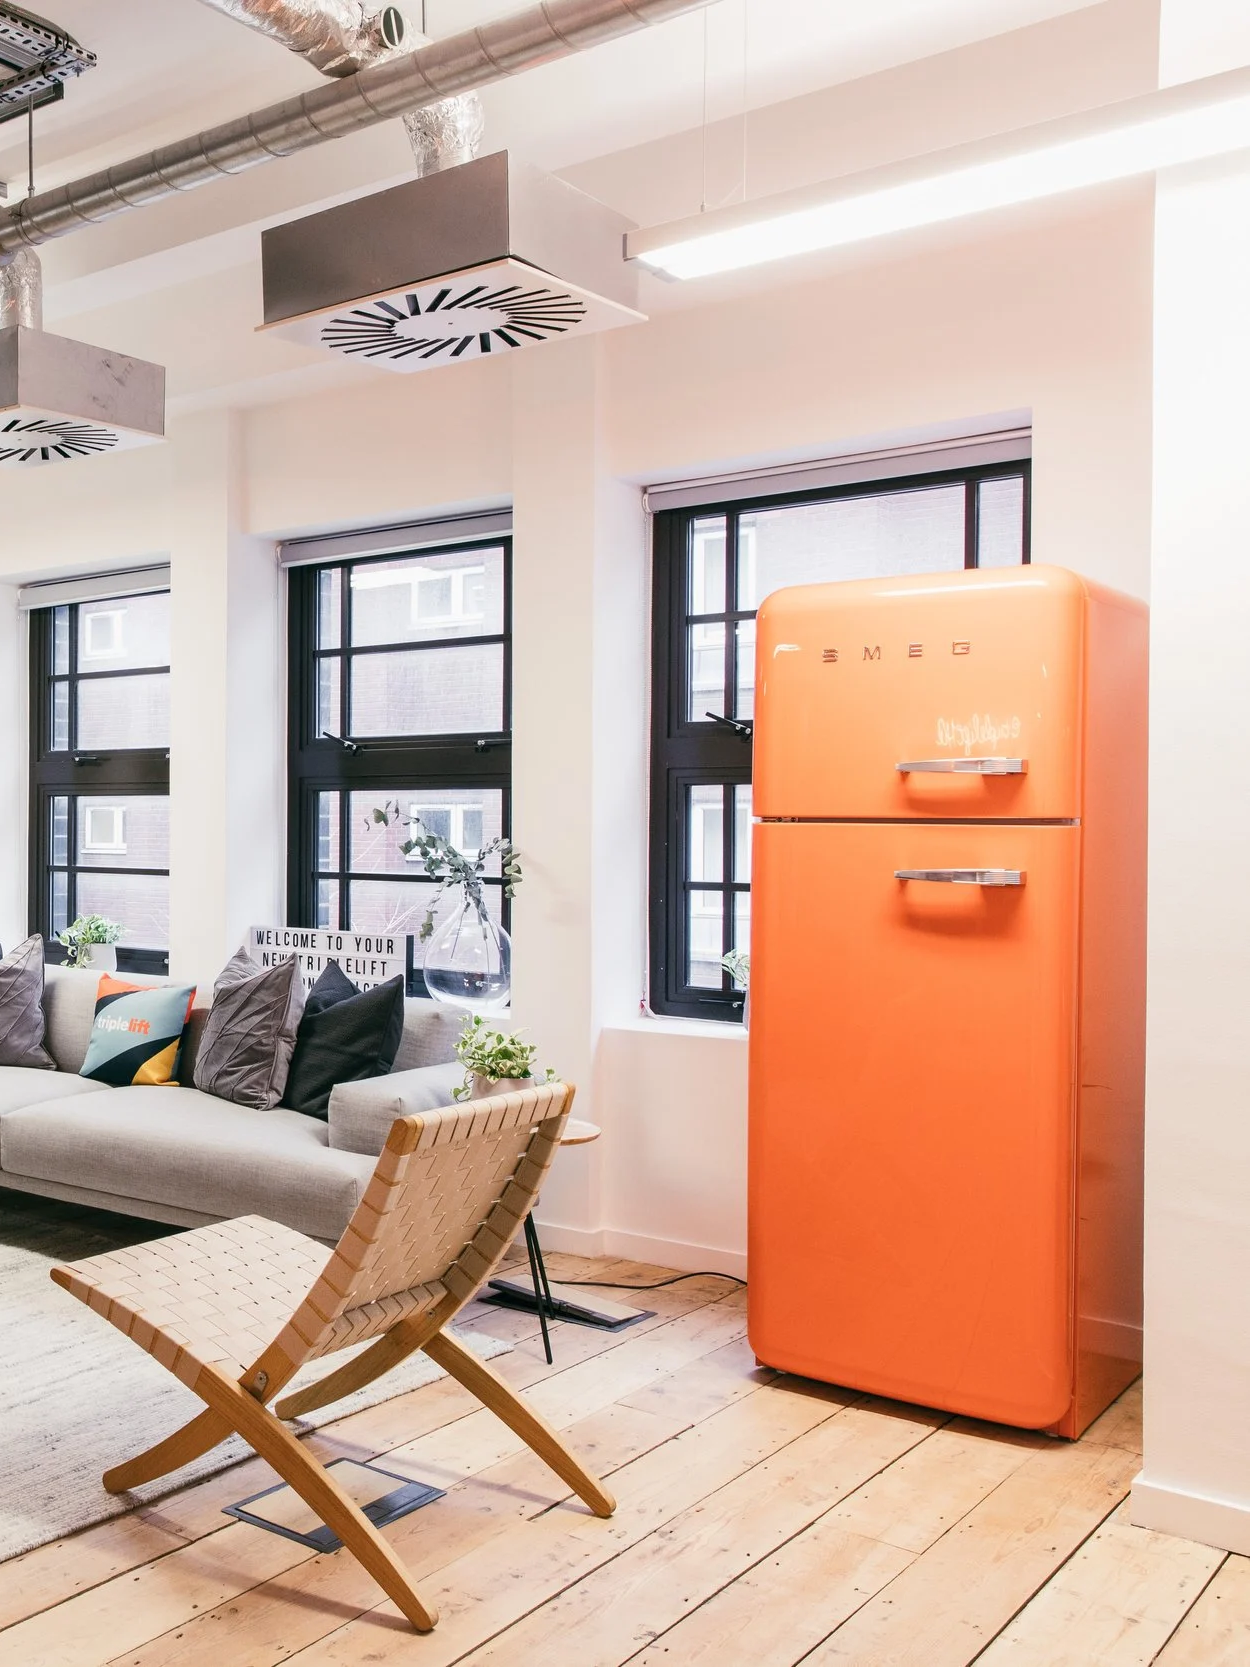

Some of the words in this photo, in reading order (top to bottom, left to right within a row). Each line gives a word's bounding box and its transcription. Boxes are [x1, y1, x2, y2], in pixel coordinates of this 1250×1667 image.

[822, 639, 971, 663] SMEG
[256, 930, 317, 949] WELCOME
[327, 935, 343, 950] TO
[355, 936, 394, 954] YOUR
[96, 1015, 151, 1035] triplelift
